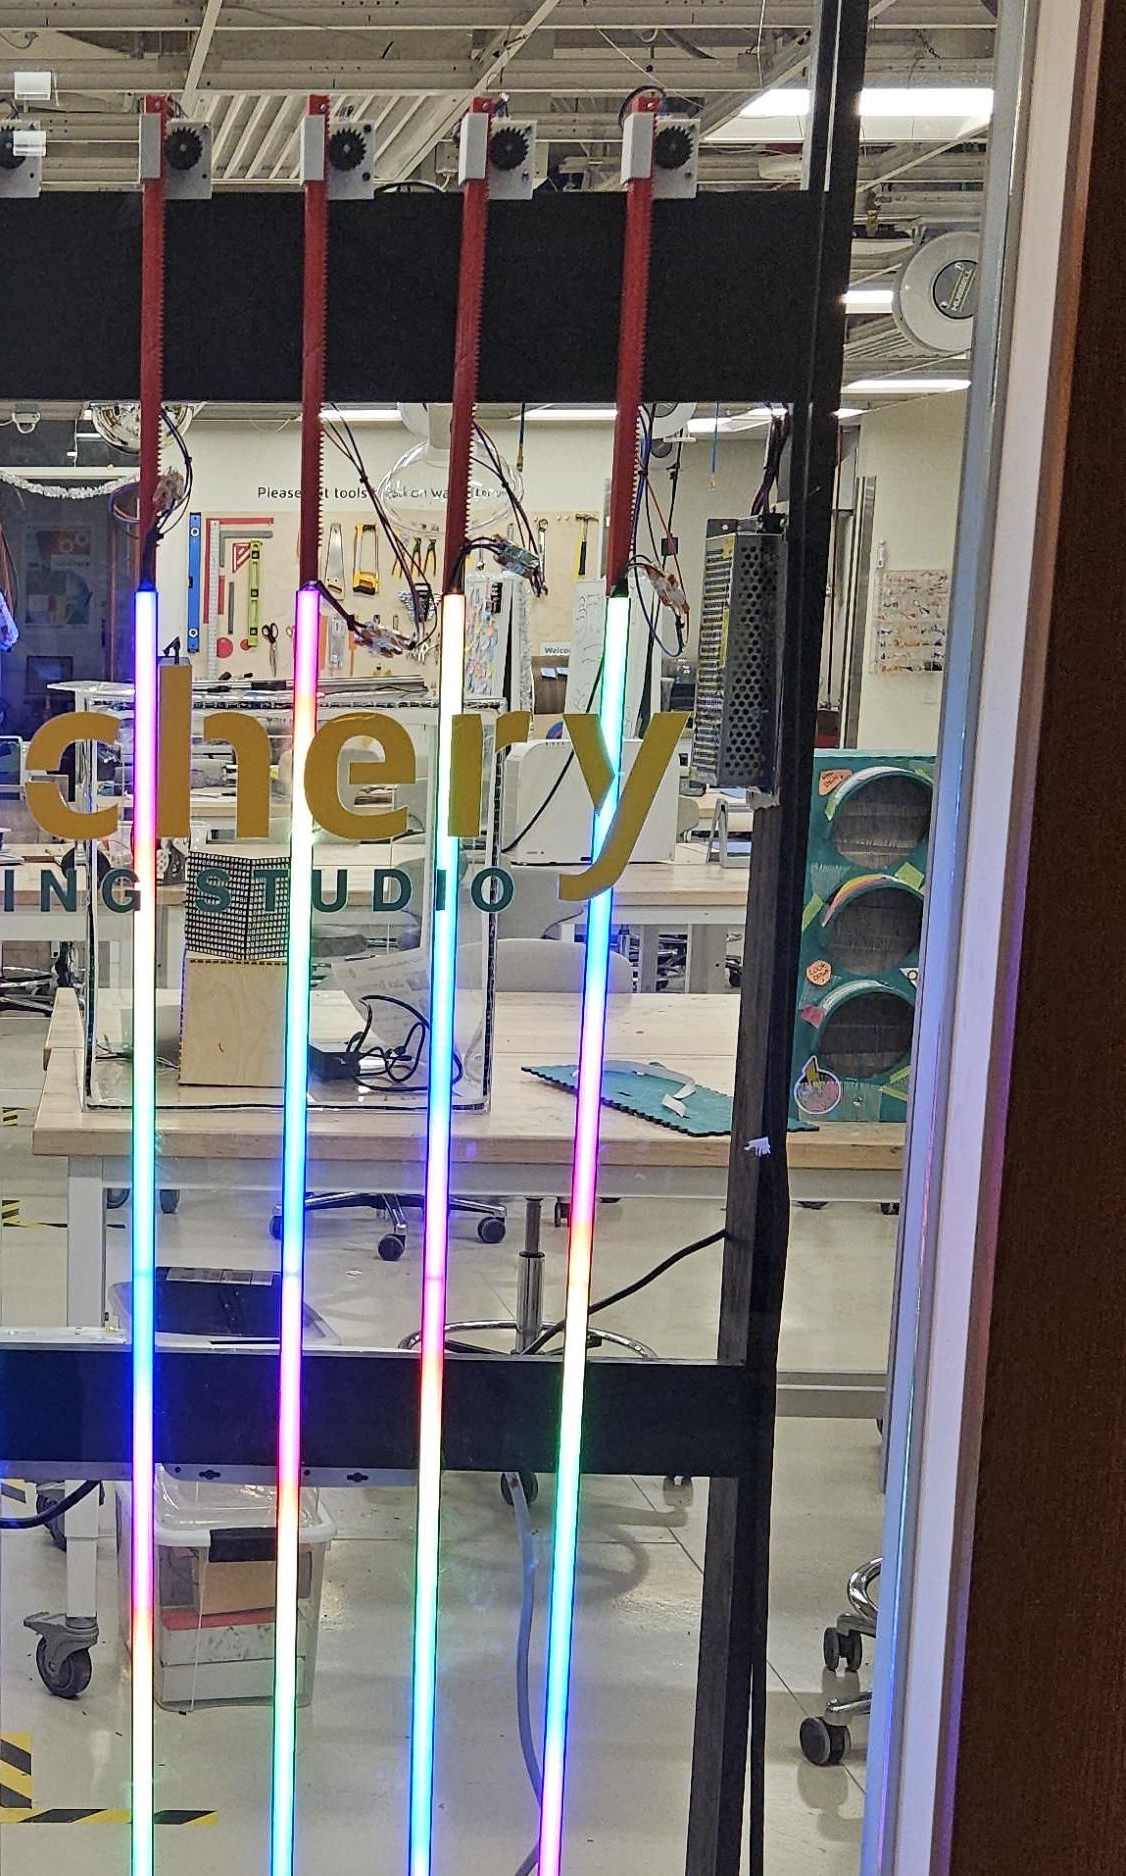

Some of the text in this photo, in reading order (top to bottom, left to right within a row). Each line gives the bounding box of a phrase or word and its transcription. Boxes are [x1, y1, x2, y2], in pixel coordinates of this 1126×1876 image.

[257, 486, 302, 499] Please
[334, 486, 367, 499] tools
[194, 867, 515, 913] STUDIO
